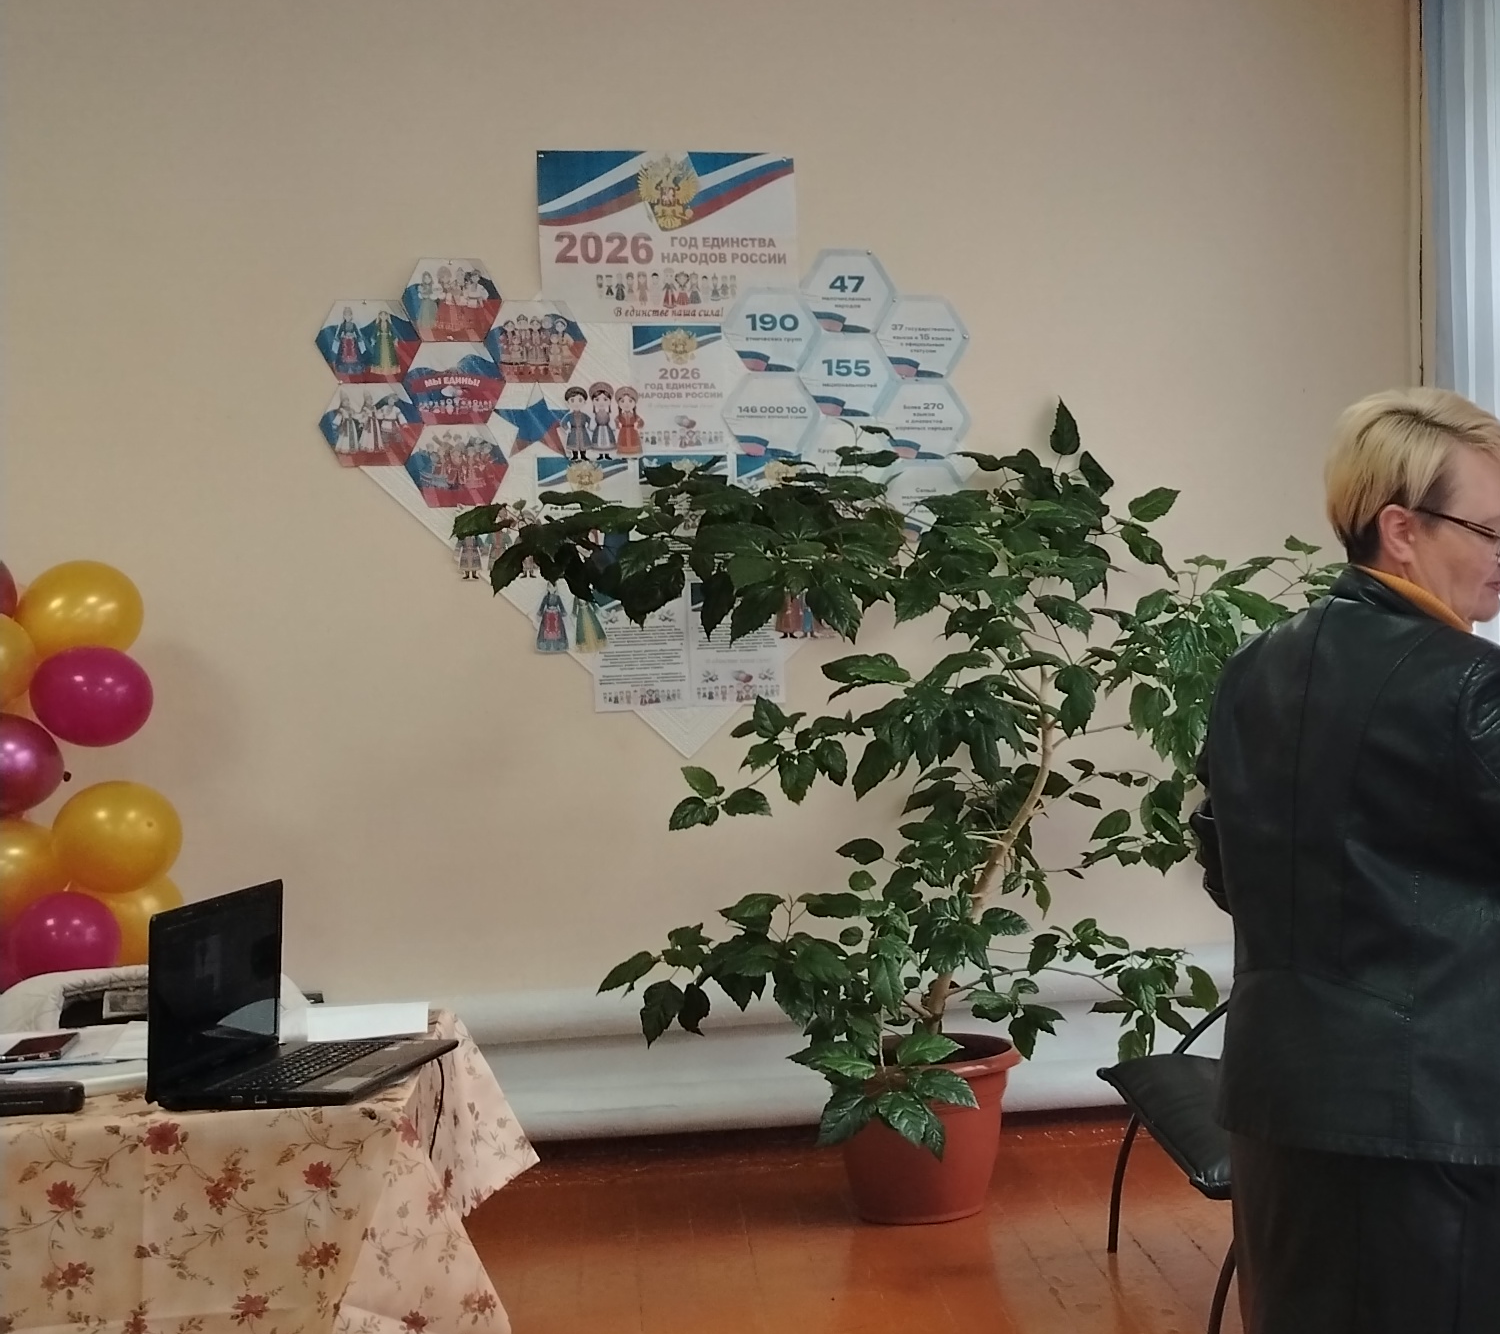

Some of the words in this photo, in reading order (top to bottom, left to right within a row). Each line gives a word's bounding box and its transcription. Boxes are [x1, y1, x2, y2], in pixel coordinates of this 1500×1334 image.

[554, 231, 654, 264] 2026
[670, 236, 698, 249] ГОД
[702, 237, 776, 250] ЕДИНСТВА
[661, 252, 727, 265] НАРОДОВ
[732, 253, 787, 265] РОССИИ
[829, 275, 865, 293] 47
[613, 307, 623, 317] В
[624, 308, 670, 317] единстве
[672, 309, 696, 317] наша
[698, 307, 724, 317] сила!
[745, 313, 799, 332] 190
[891, 323, 904, 331] 37
[658, 368, 701, 380] 2026
[821, 359, 871, 377] 155
[424, 377, 442, 387] МЫ
[760, 406, 784, 414] 000
[785, 406, 807, 414] 100
[923, 402, 944, 410] 270
